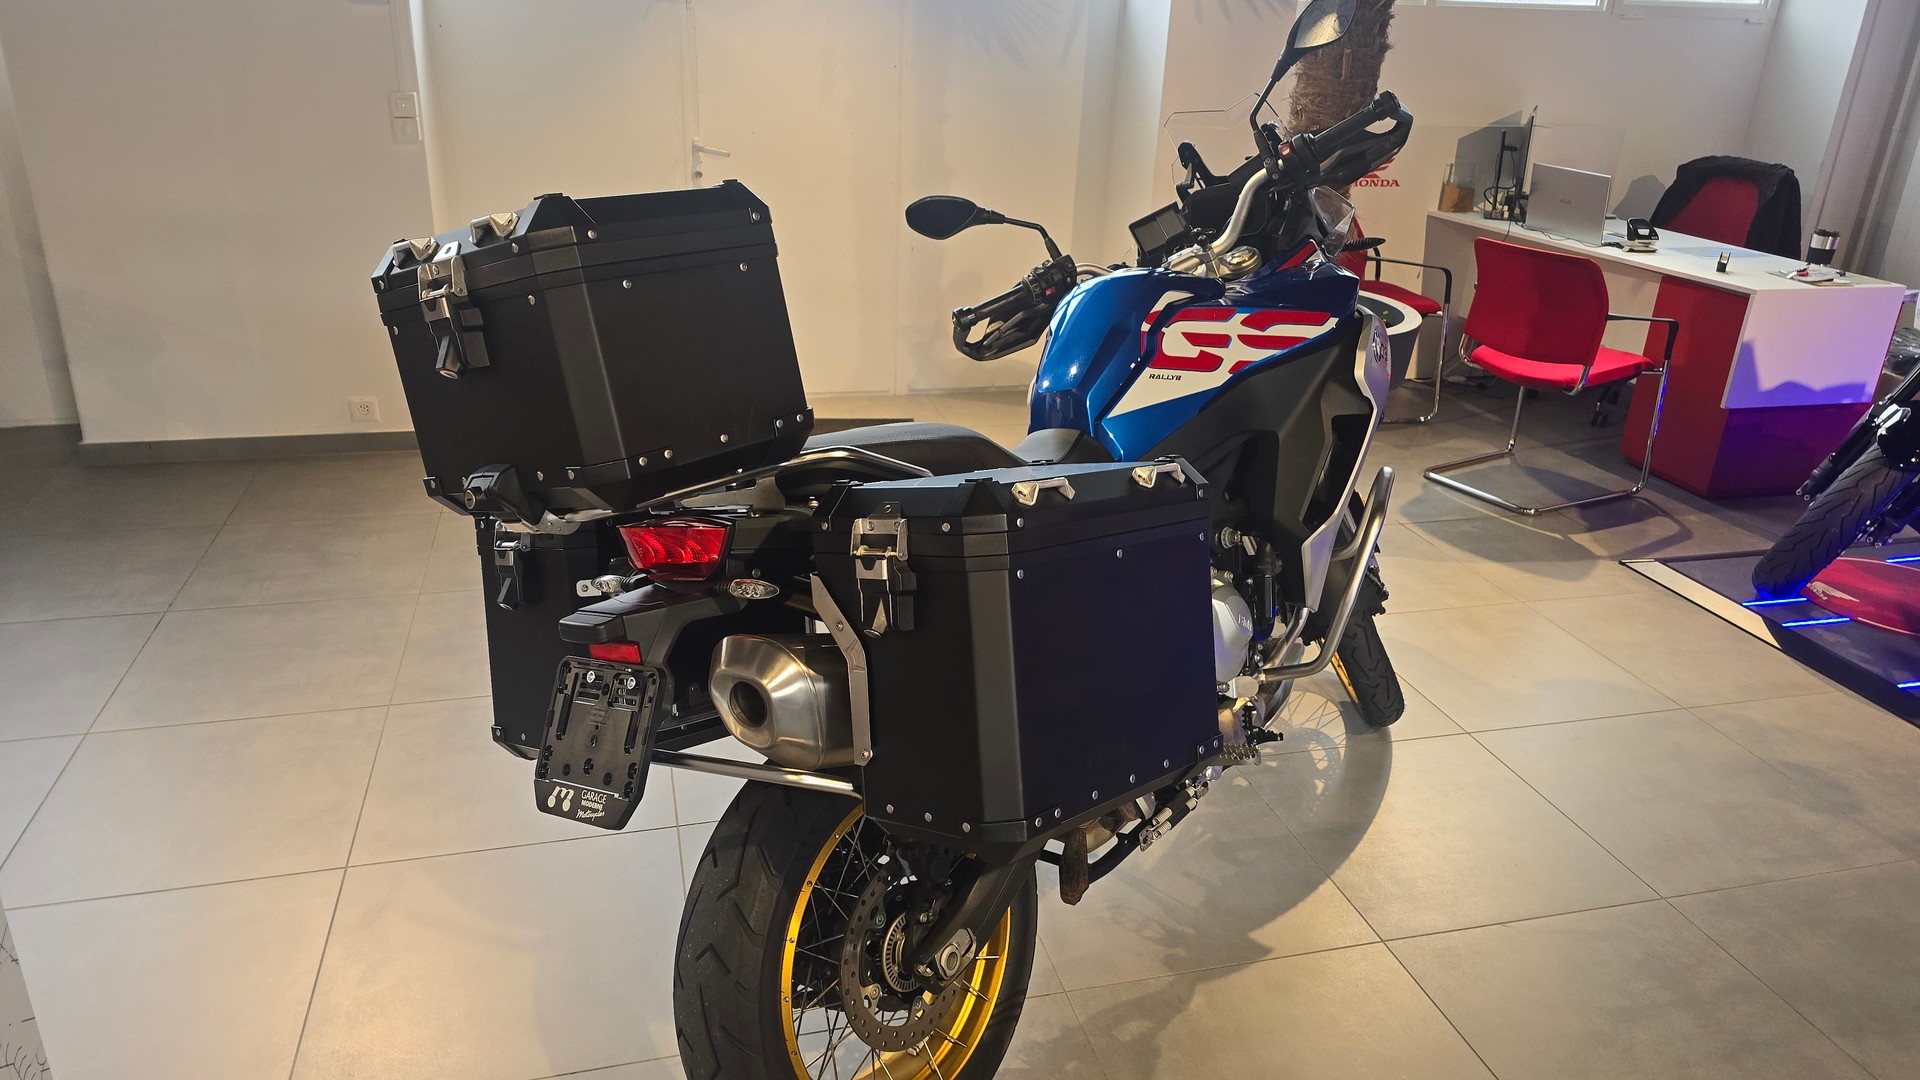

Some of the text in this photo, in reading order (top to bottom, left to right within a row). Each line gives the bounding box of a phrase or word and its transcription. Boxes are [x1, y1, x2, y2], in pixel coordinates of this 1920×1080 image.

[1141, 307, 1331, 374] GS
[581, 790, 607, 804] GARAGE
[581, 799, 604, 810] MODERNE
